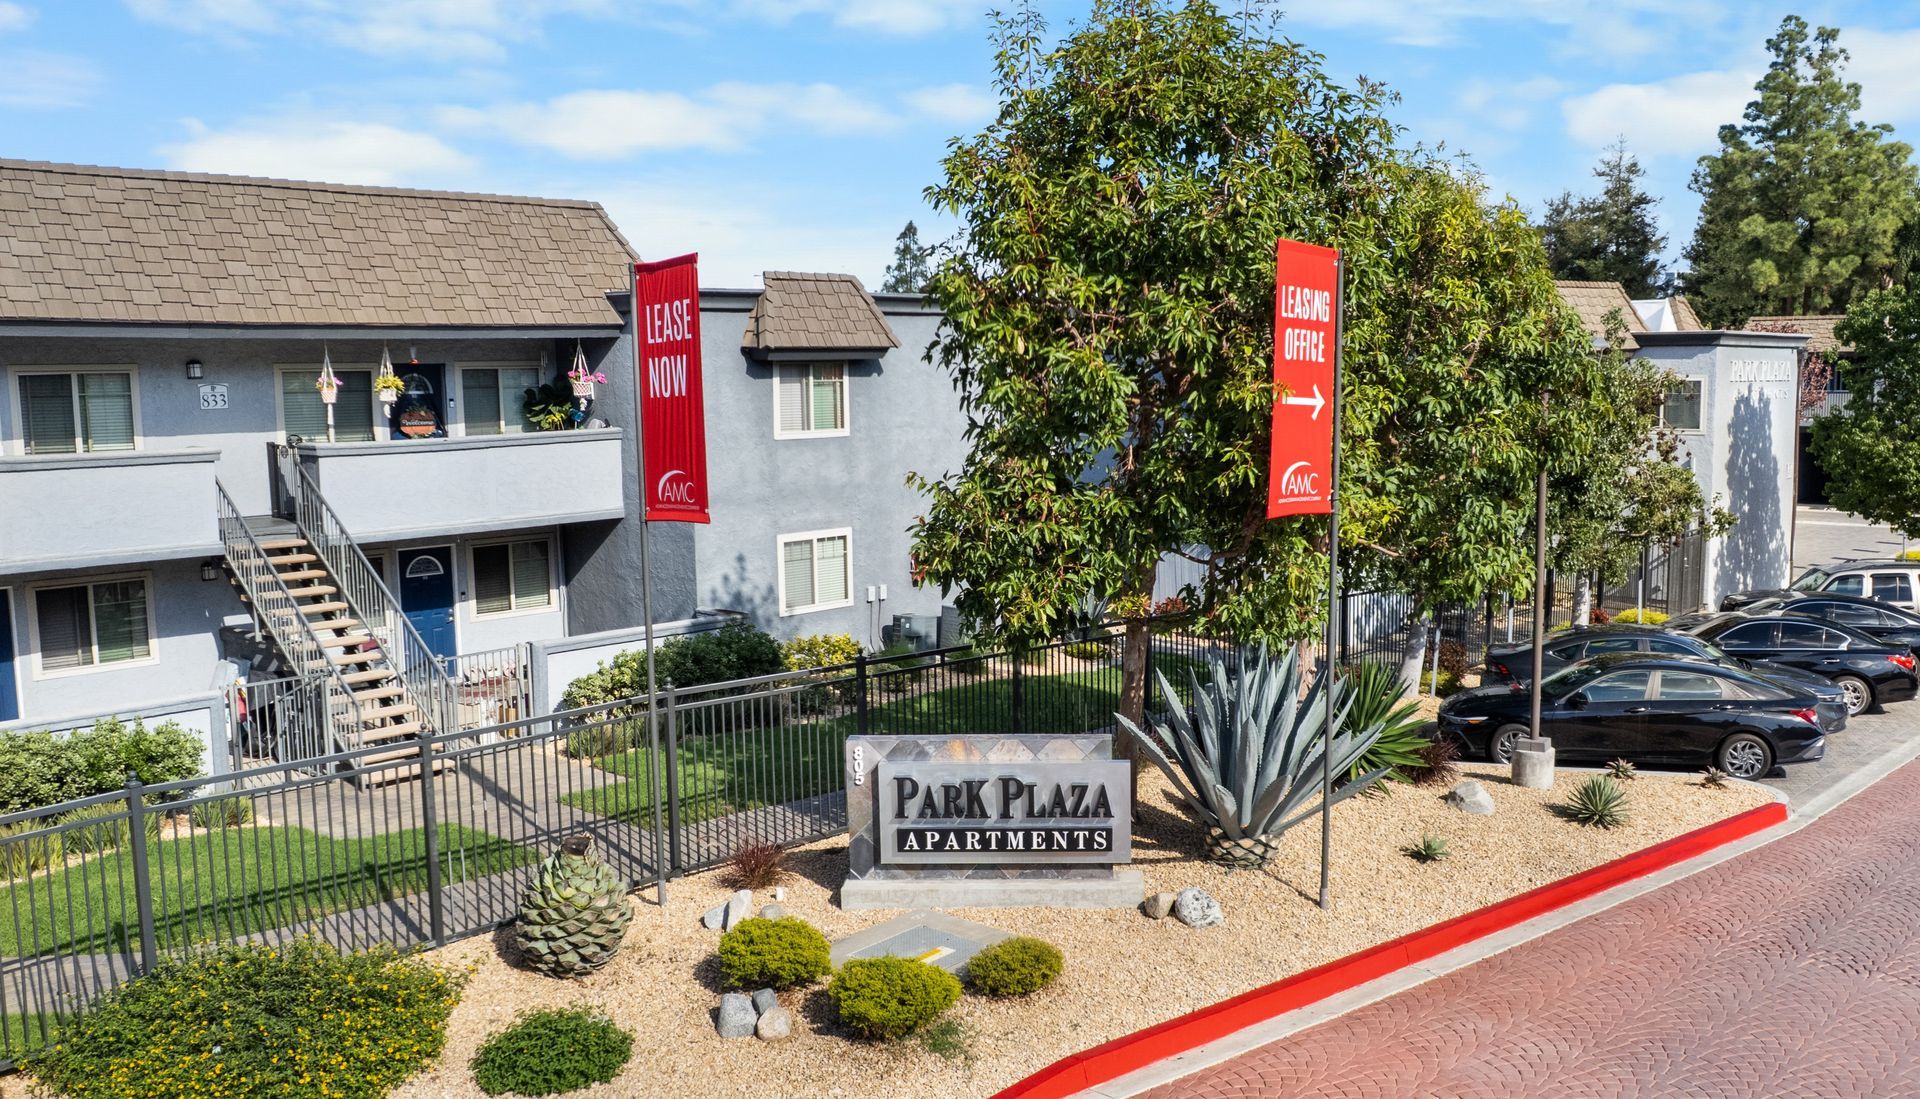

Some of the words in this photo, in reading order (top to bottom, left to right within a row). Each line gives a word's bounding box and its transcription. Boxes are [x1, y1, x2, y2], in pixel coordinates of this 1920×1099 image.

[1281, 285, 1330, 322] LEASING
[646, 299, 692, 344] LEASE
[1284, 327, 1325, 362] OFFICE
[649, 354, 687, 398] NOW
[1729, 360, 1757, 382] PARK
[1759, 360, 1792, 382] PLAZA
[202, 393, 227, 408] 833
[663, 482, 696, 503] AMC
[1287, 473, 1319, 495] AMC
[854, 746, 864, 785] 805
[893, 776, 991, 819] PARK
[998, 776, 1115, 819] PLAZA
[904, 830, 1107, 851] APARTMENTS
